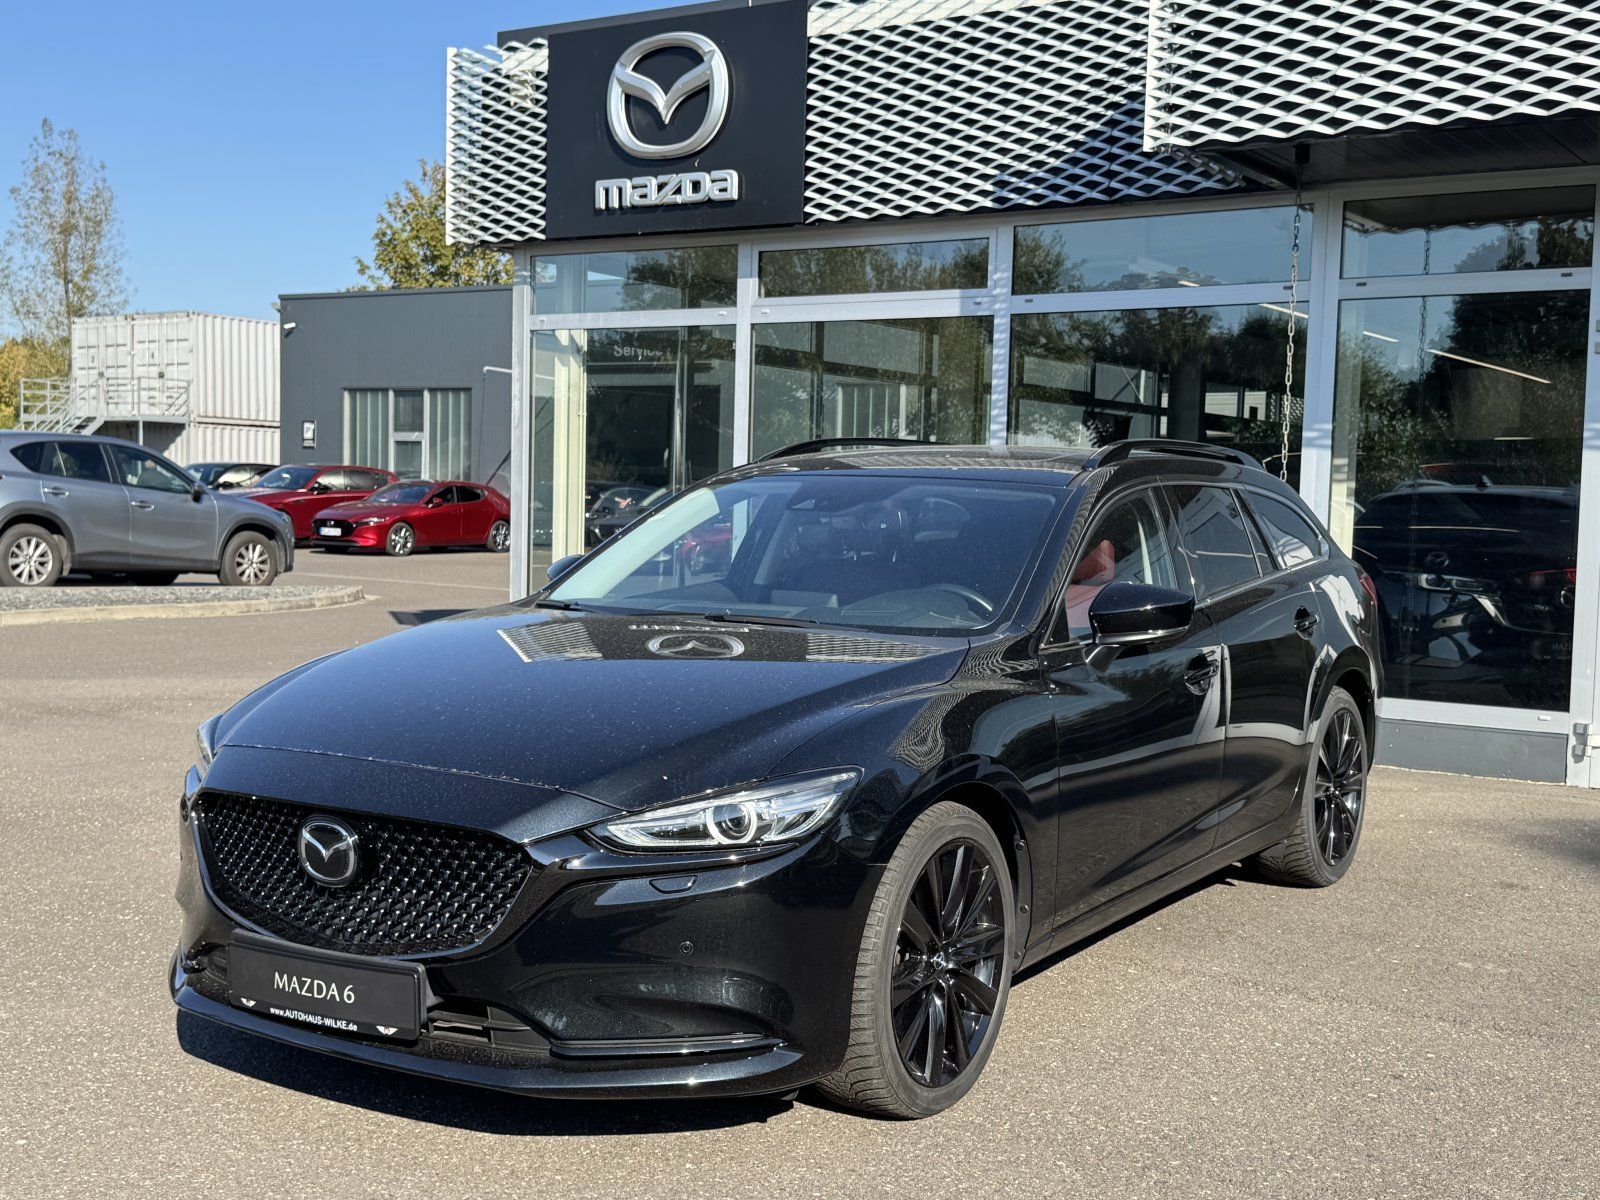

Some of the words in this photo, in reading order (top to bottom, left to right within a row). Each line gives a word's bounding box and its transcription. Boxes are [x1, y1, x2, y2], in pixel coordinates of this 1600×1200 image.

[594, 169, 739, 211] mazda
[274, 971, 340, 1002] MAZDA
[343, 984, 355, 1004] 6
[269, 1007, 358, 1032] www.AUTOHAUS-WILKE.de
